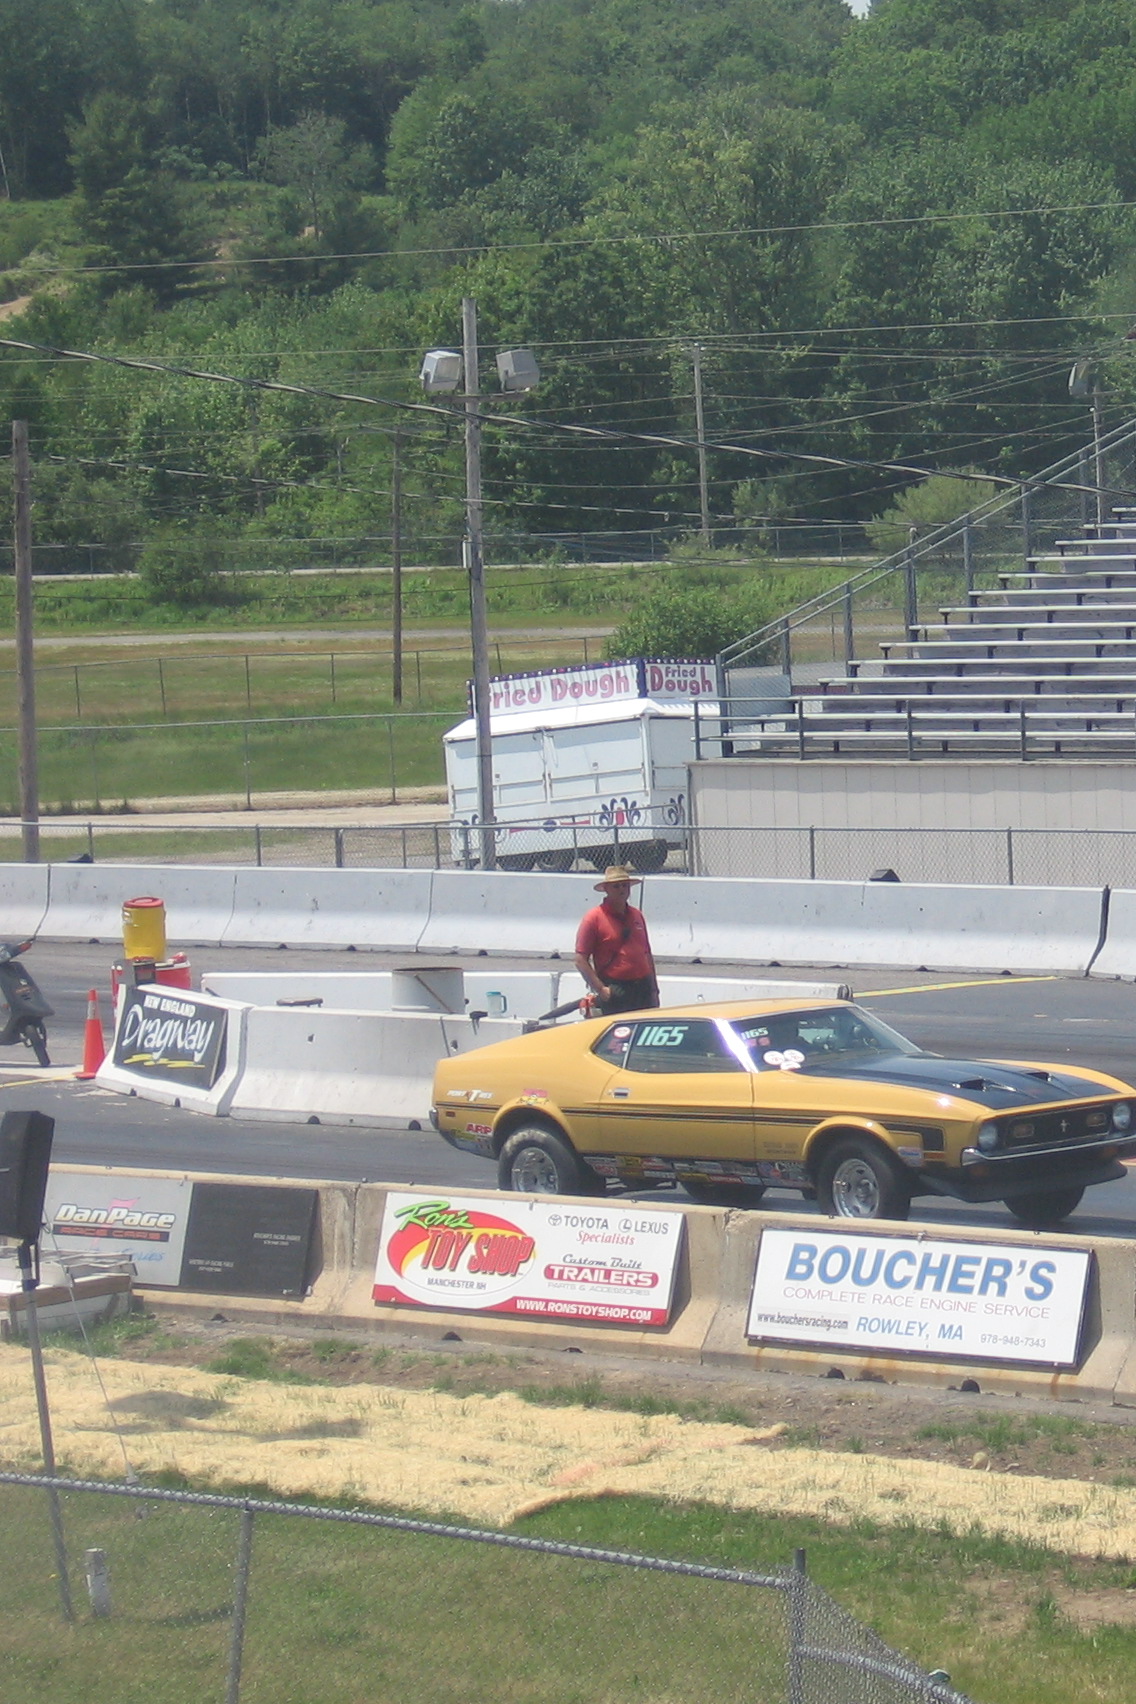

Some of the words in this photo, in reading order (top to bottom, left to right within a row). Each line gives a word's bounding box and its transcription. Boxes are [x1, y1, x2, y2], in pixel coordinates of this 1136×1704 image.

[650, 666, 713, 695] Dough
[665, 666, 697, 678] Fried
[489, 680, 542, 709] ried
[551, 670, 630, 699] Dough
[144, 995, 161, 1009] NEW
[161, 998, 197, 1018] ENGLAND
[122, 1004, 214, 1063] Dragway
[636, 1026, 689, 1046] 1165
[465, 1123, 493, 1135] ARP
[394, 1200, 474, 1231] Ron's
[564, 1215, 609, 1230] TOYOTA
[634, 1220, 669, 1235] LEXUS
[576, 1230, 635, 1245] Specialists
[421, 1227, 473, 1271] TOY
[467, 1232, 535, 1276] SHOP
[562, 1254, 608, 1267] Custom
[610, 1257, 642, 1269] Built
[549, 1265, 653, 1287] TRAILERS
[785, 1242, 1057, 1302] BOUCHER'S
[547, 1282, 576, 1290] PARTS
[578, 1283, 586, 1291] &
[589, 1285, 651, 1296] ACCESSORIES
[516, 1299, 652, 1321] WWW.RONSTOYSHOP.COM
[783, 1286, 867, 1304] COMPLETE
[872, 1293, 914, 1308] RACE
[920, 1298, 978, 1314] ENGINE
[984, 1302, 1051, 1319] SERVICE
[757, 1312, 849, 1331] www.bouchersracing.com
[856, 1316, 929, 1340] ROWLEY,
[938, 1323, 963, 1341] MA
[980, 1333, 1046, 1348] 978-948-7343
